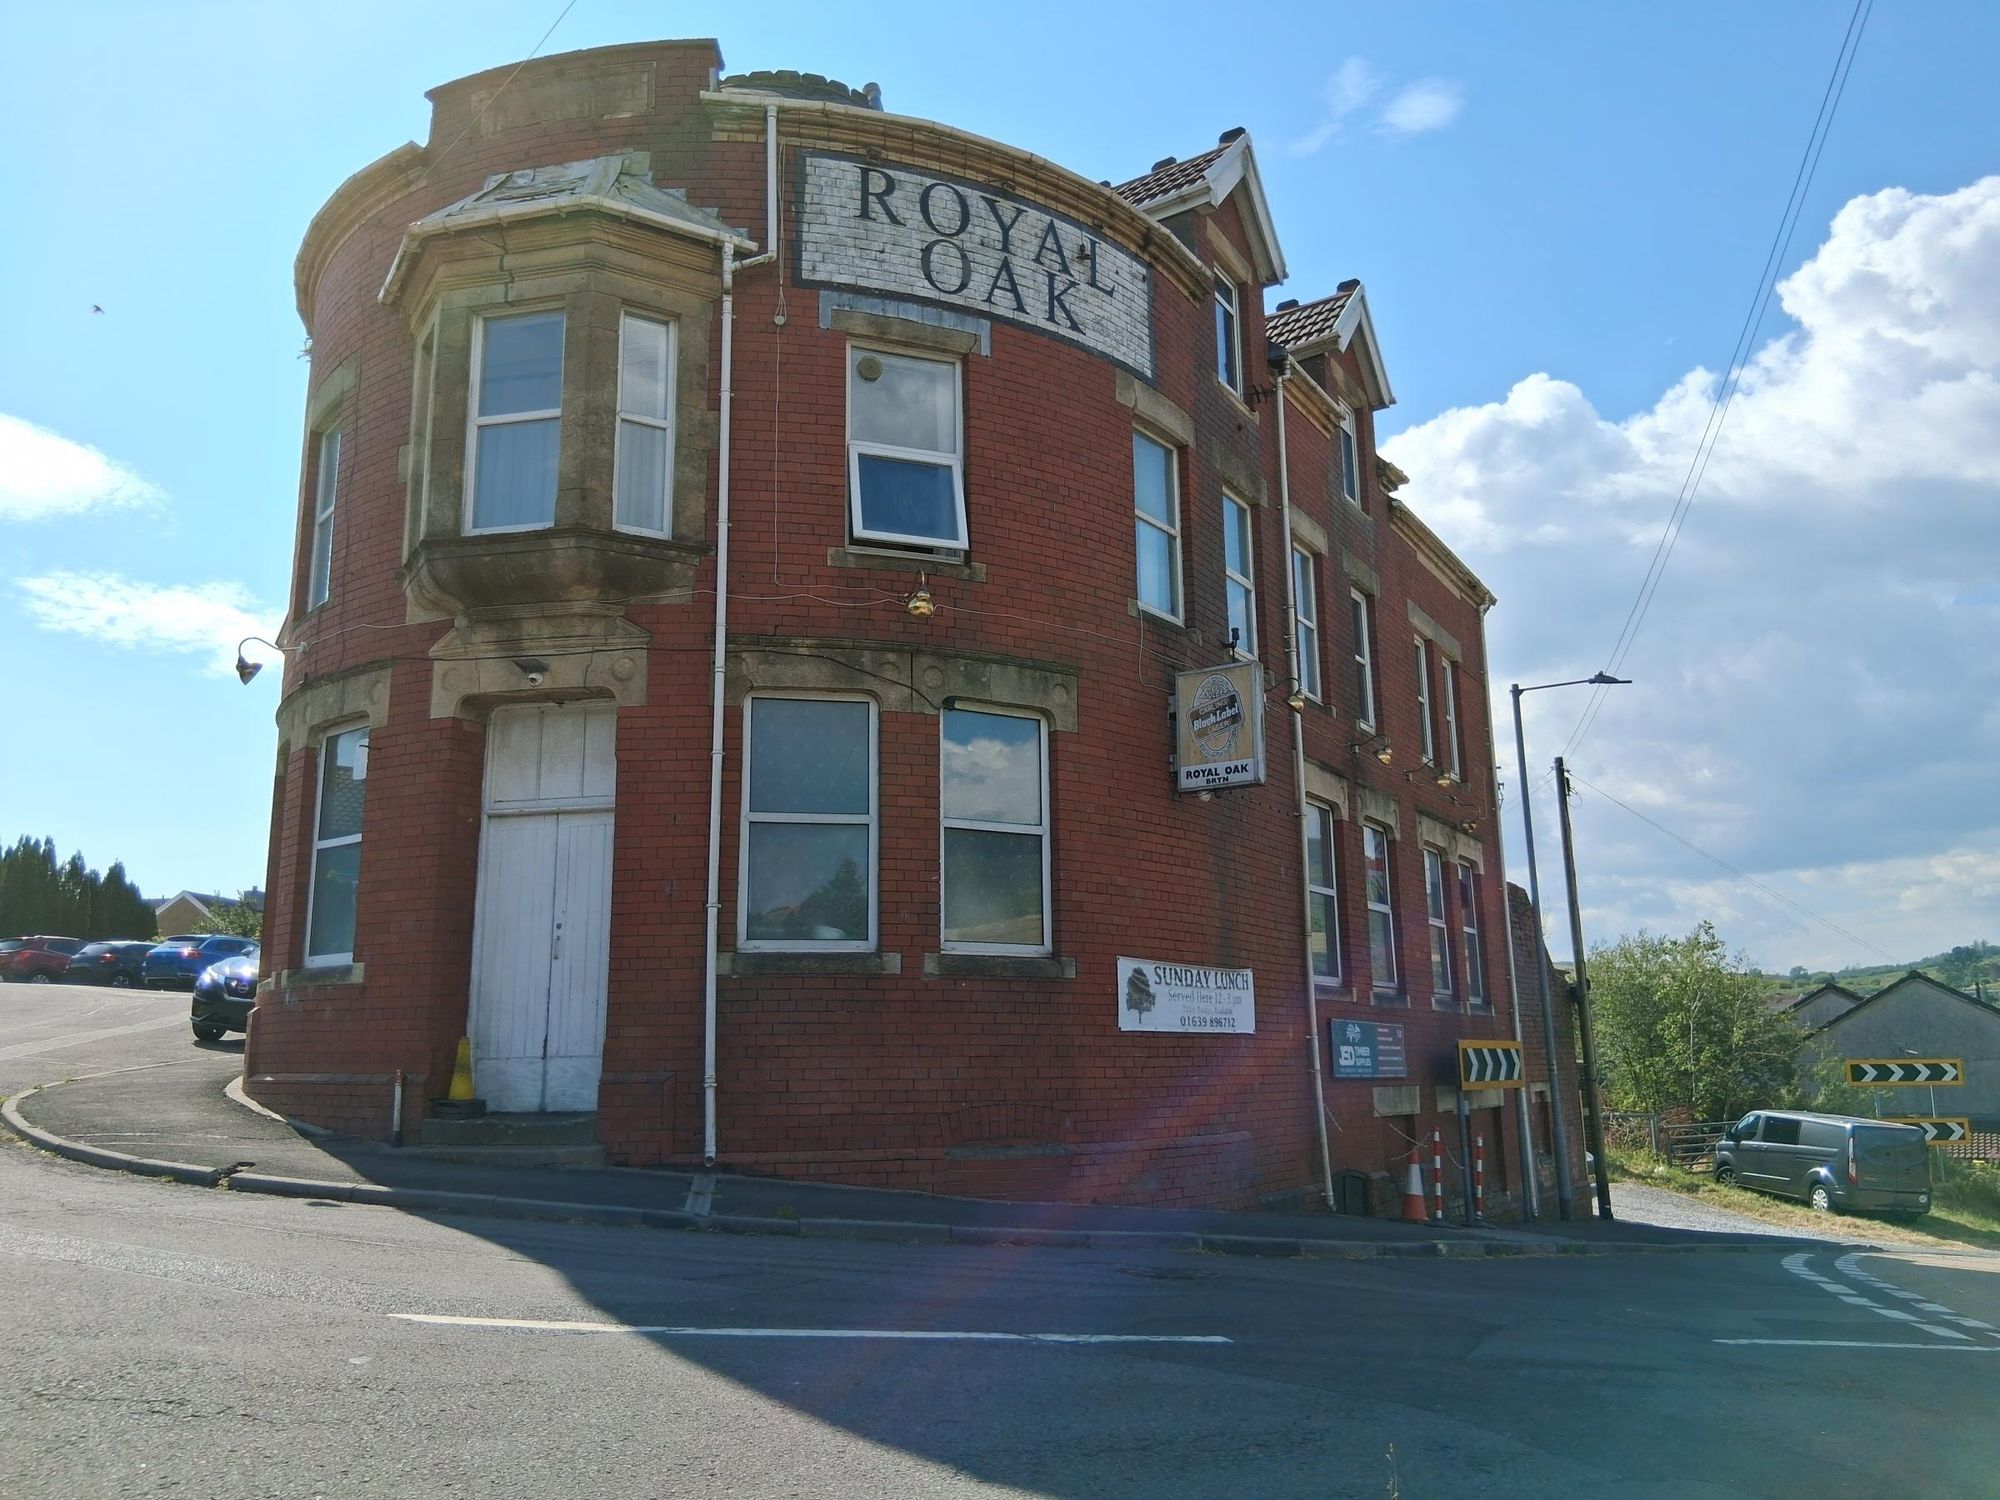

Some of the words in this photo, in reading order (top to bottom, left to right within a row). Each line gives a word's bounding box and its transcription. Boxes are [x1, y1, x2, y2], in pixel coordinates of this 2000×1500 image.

[853, 165, 1115, 297] ROYAL
[920, 238, 1086, 336] OAK
[1199, 700, 1228, 716] CARLING
[1193, 713, 1216, 731] Black
[1216, 703, 1239, 721] Label
[1208, 721, 1230, 733] LAGER
[1185, 767, 1219, 780] ROYAL
[1225, 763, 1249, 775] OAK
[1206, 776, 1229, 785] BRYN
[1153, 965, 1212, 989] SUNDAY
[1215, 972, 1249, 991] LUNCH
[1168, 989, 1195, 1002] Served
[1197, 990, 1213, 1004] Here
[1180, 1015, 1208, 1028] 01639
[1209, 1016, 1236, 1028] 896712
